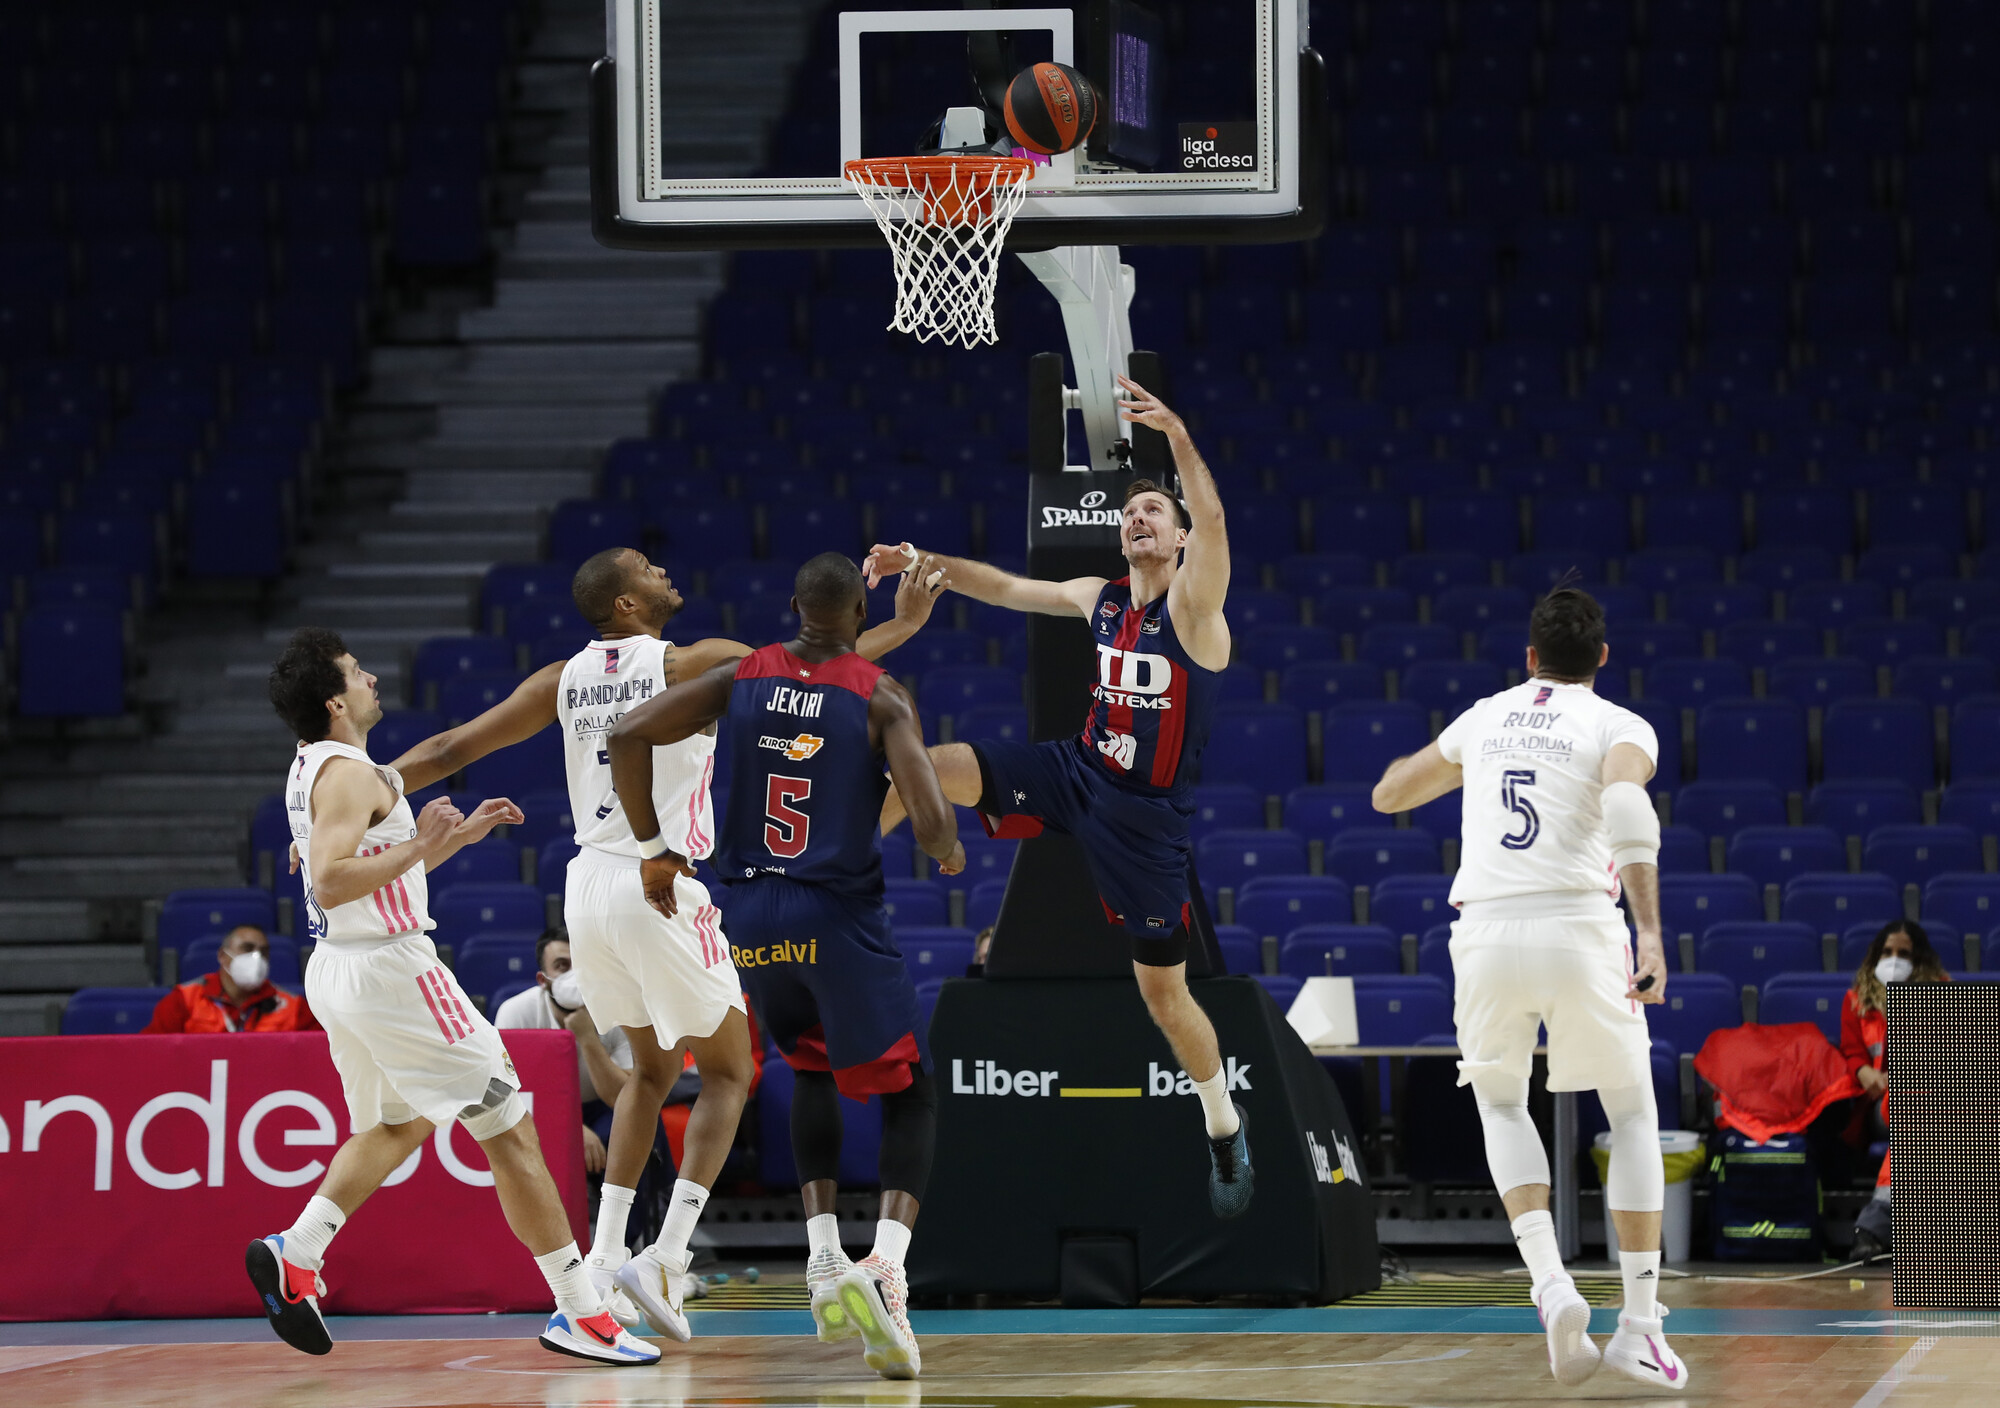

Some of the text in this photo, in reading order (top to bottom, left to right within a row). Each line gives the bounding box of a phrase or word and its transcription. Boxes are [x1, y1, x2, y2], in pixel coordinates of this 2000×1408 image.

[1183, 137, 1214, 155] liga
[1183, 153, 1253, 169] endesa
[1041, 506, 1124, 528] SPALDIN
[1097, 643, 1172, 695] TD
[567, 678, 653, 710] RANDOLPH
[766, 686, 824, 718] JEKIRI
[1092, 686, 1172, 710] SYSTEMS
[575, 712, 627, 732] PALLA
[1503, 711, 1562, 730] RUDY
[758, 735, 815, 754] KIROLBET
[1481, 735, 1573, 752] PALLADIUM
[764, 773, 811, 859] 5
[1501, 770, 1540, 850] 5
[731, 938, 817, 968] Recalvi
[952, 1057, 1253, 1097] Liber bak
[0, 1059, 534, 1191] nde
